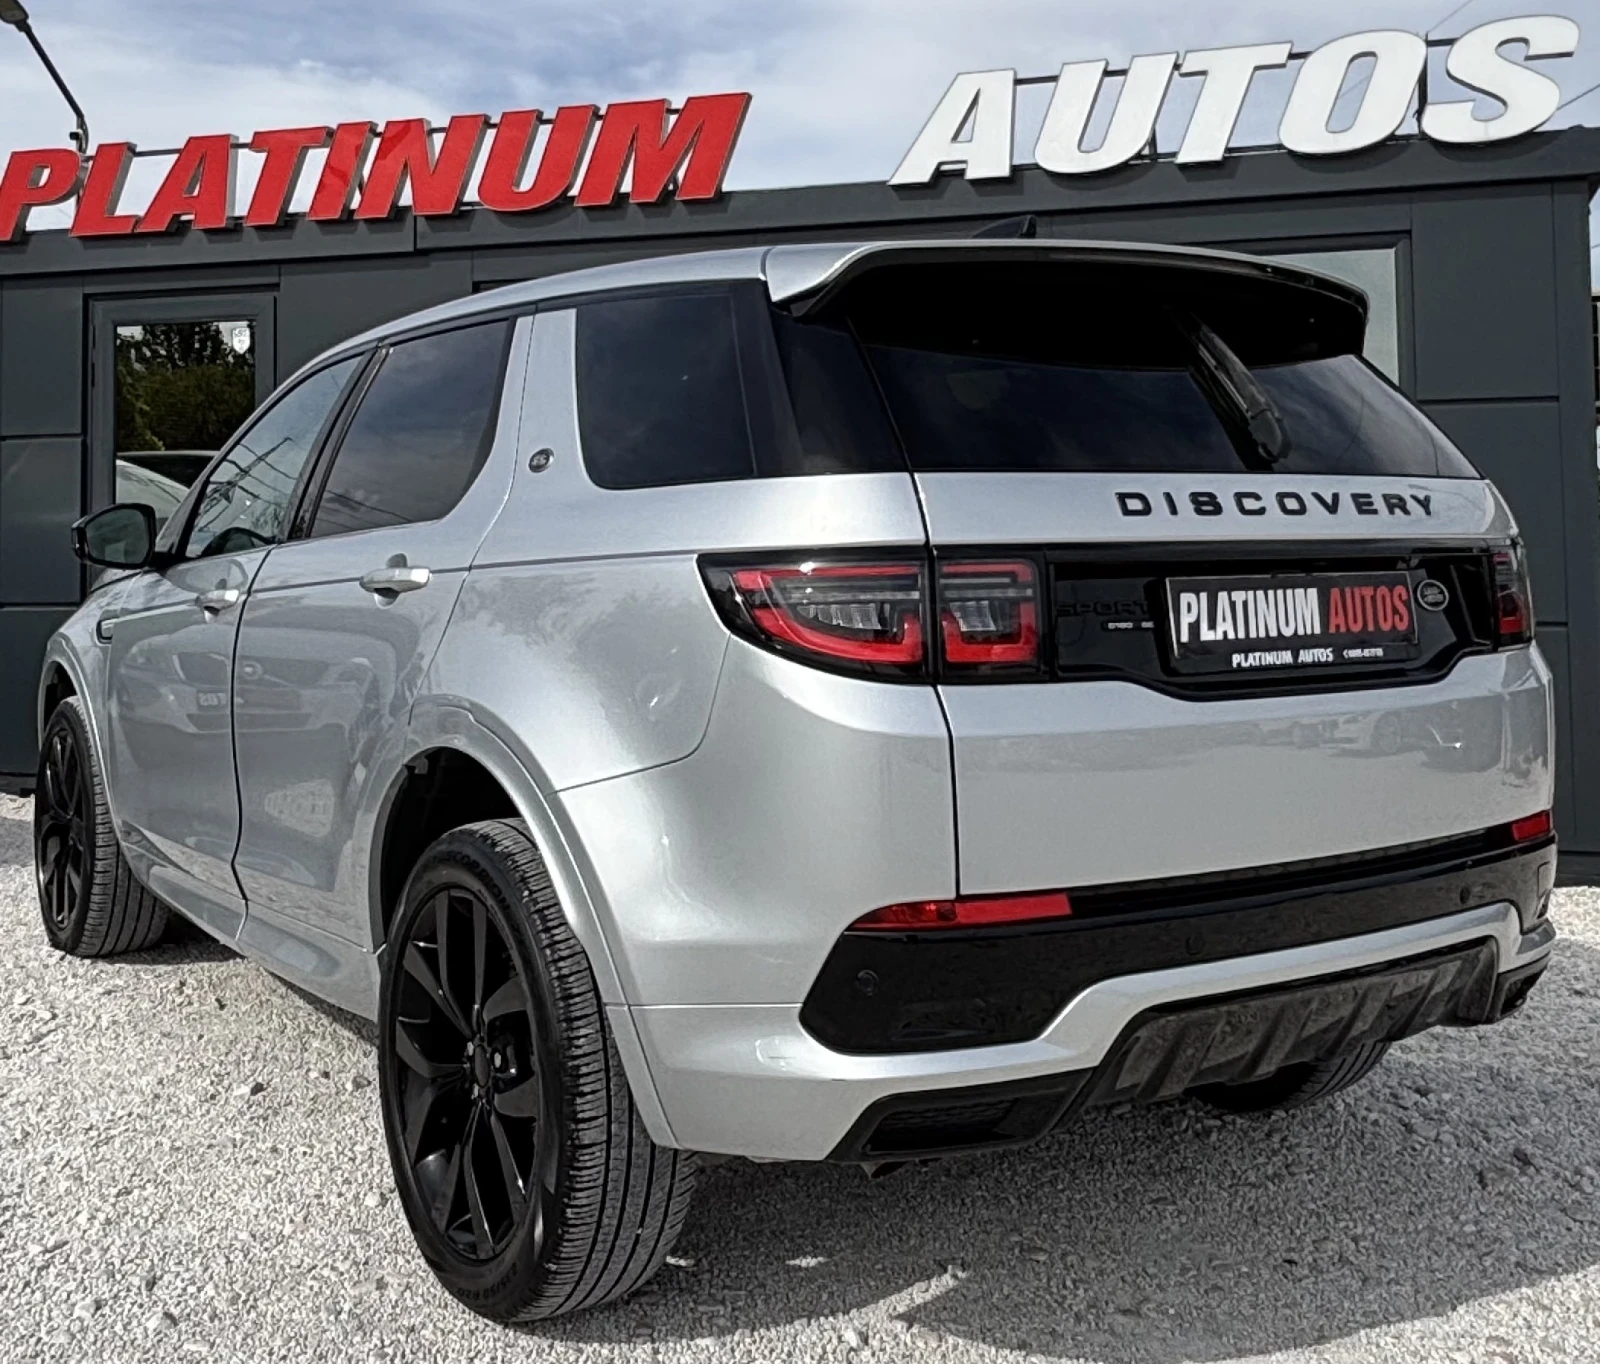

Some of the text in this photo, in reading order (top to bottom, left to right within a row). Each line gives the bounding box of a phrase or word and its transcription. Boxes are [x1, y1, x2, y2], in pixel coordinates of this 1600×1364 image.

[0, 15, 1580, 242] PLATINUM AUTOS
[1115, 491, 1432, 517] DISCOVERY
[1180, 585, 1410, 643] PLATINUM AUTOS
[1232, 649, 1293, 668] PLATINUM
[1297, 647, 1334, 663] AUTOS
